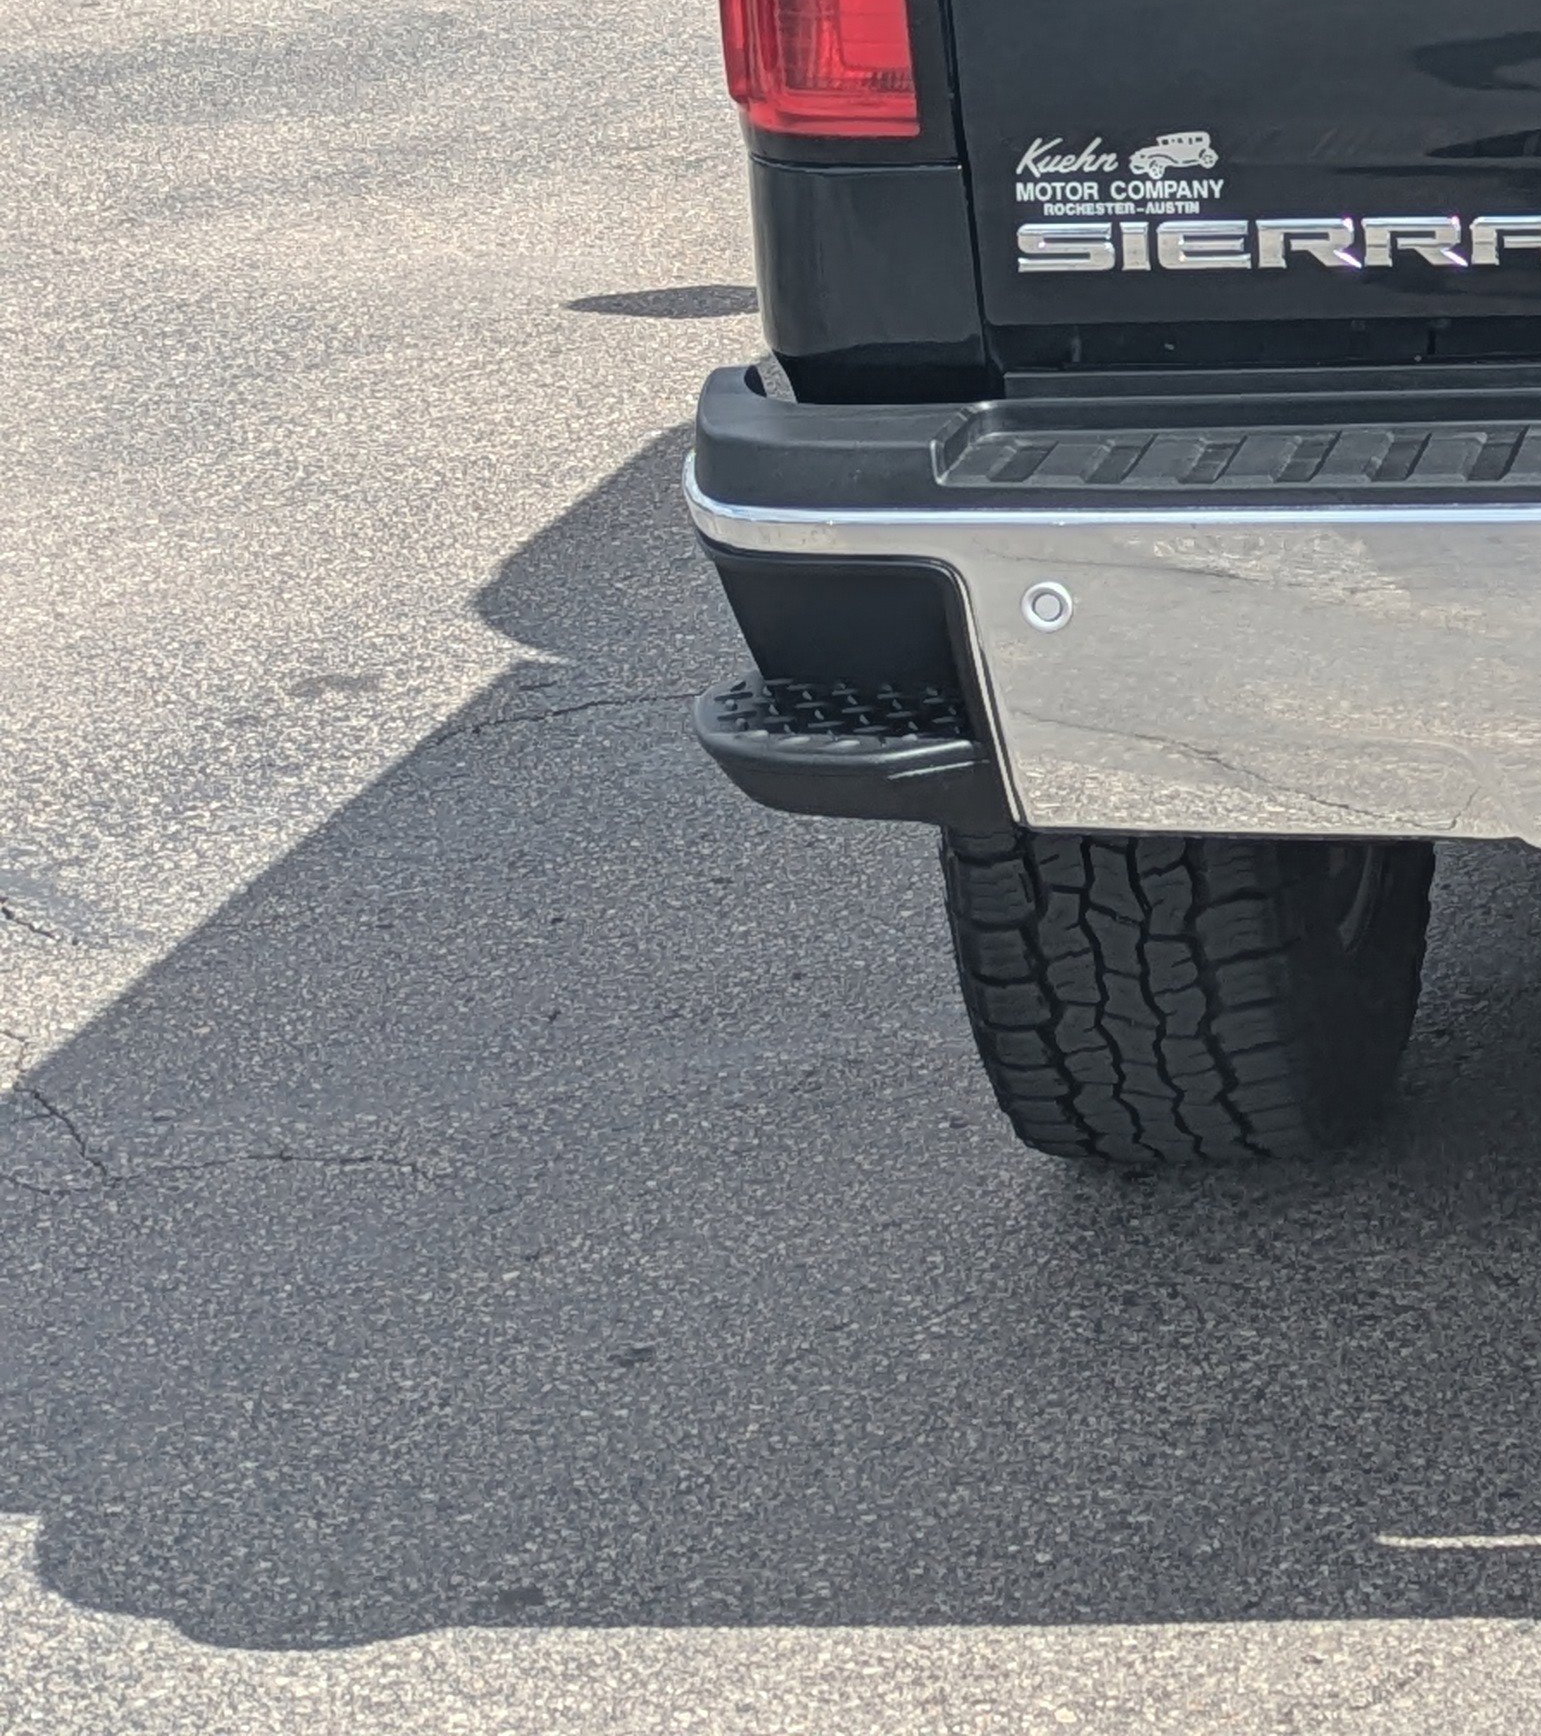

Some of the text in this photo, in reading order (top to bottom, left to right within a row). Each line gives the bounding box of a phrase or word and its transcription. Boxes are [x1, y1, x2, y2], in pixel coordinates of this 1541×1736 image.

[1016, 137, 1119, 178] Kuehn
[1016, 179, 1224, 202] MOTOR COMPANY
